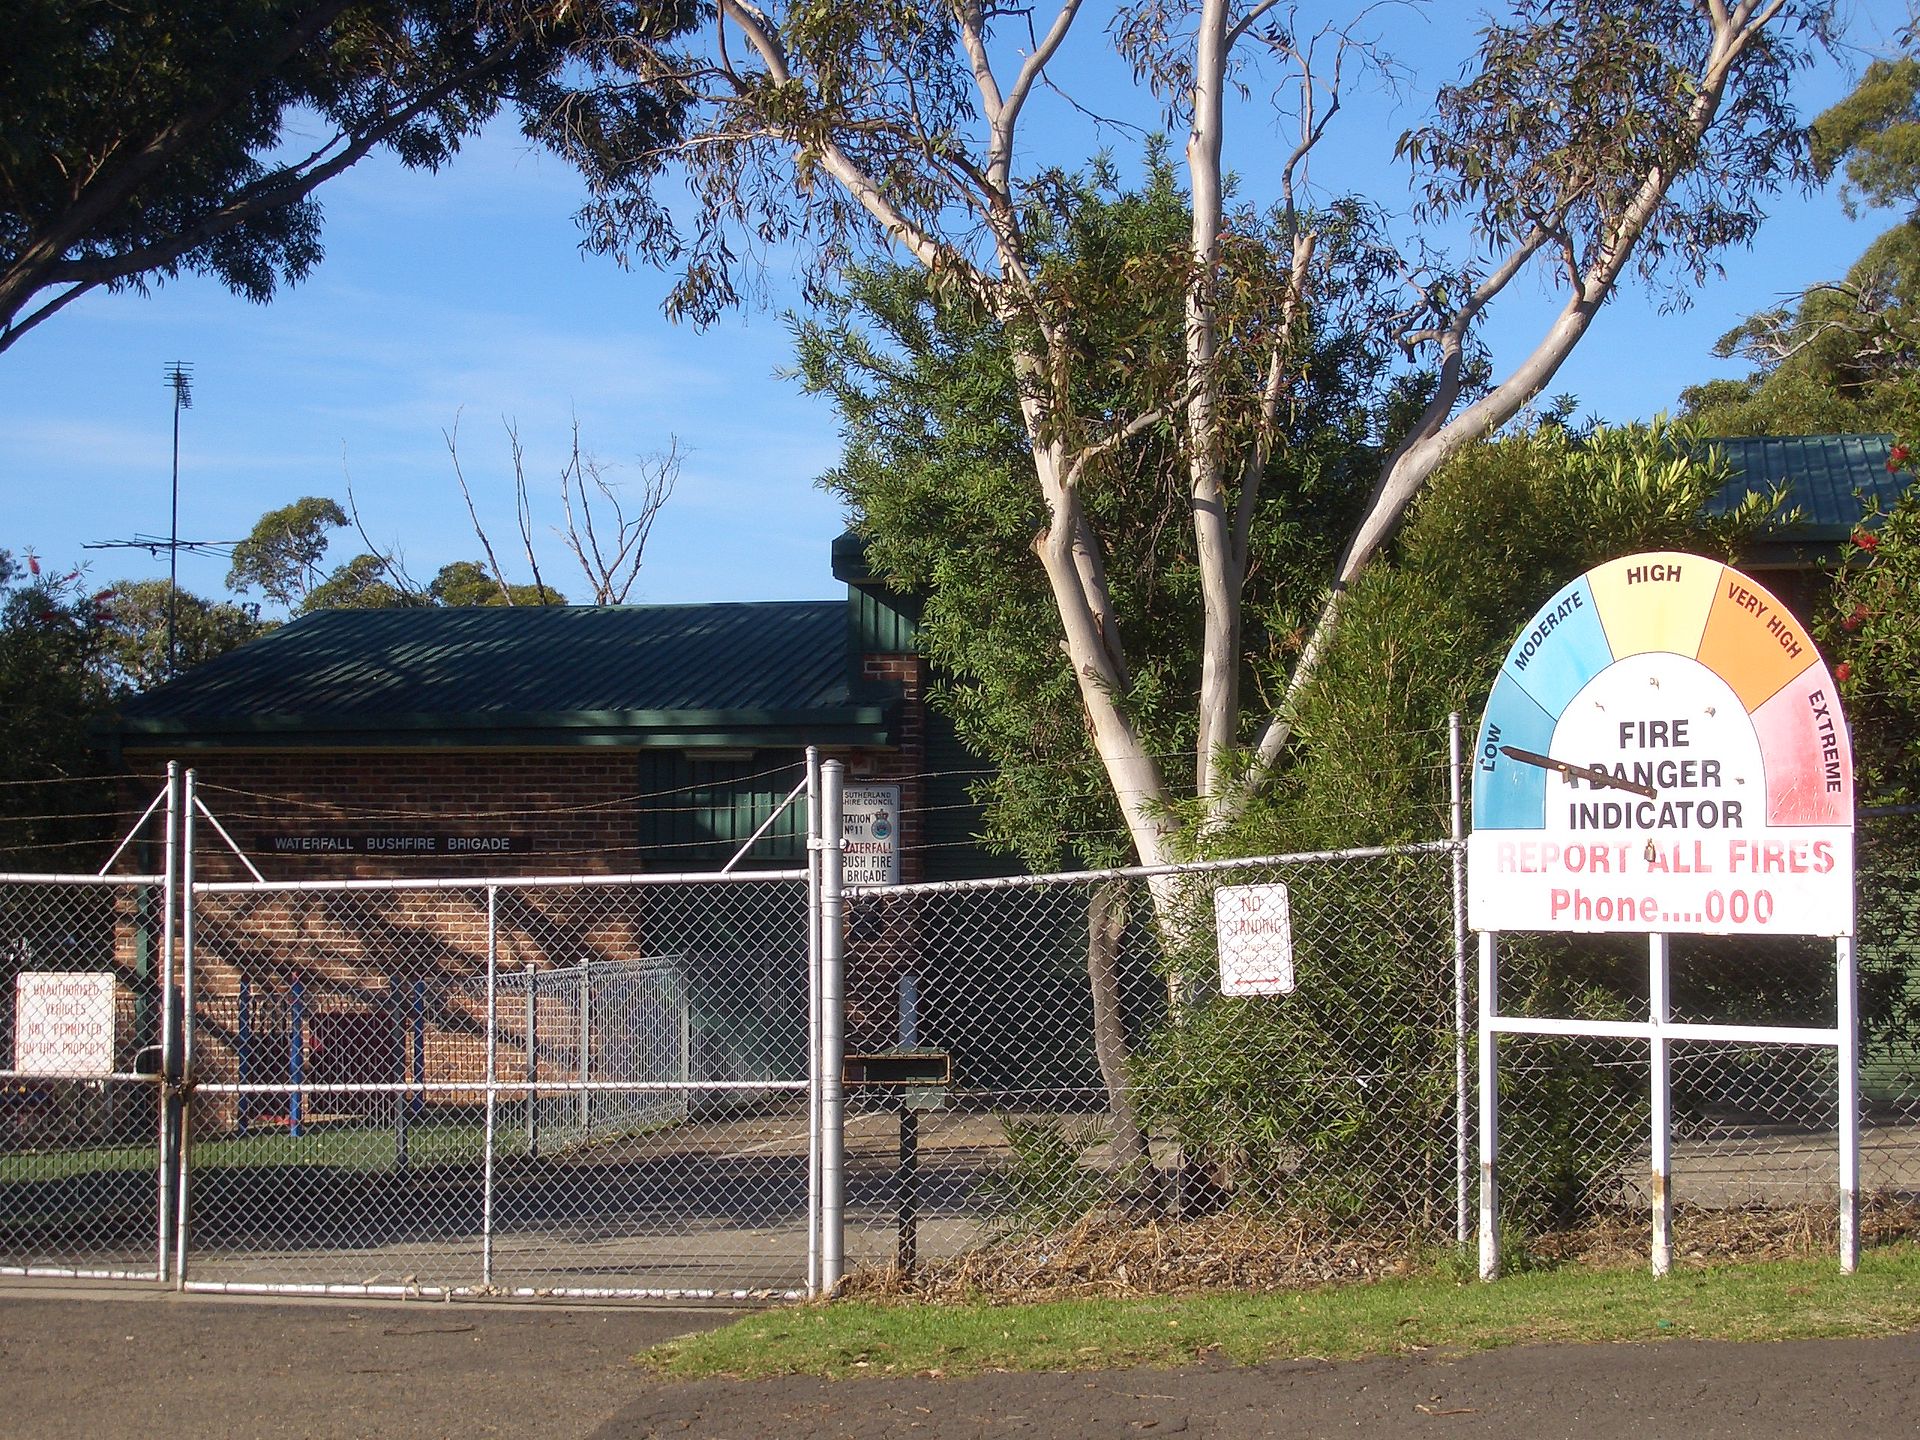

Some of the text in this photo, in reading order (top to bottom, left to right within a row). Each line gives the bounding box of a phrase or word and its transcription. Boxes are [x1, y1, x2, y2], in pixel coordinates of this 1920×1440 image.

[1626, 564, 1682, 585] HIGH
[1727, 582, 1803, 659] VERY HIGH
[1513, 591, 1584, 672] MODERATE
[1619, 719, 1690, 749] FIRE
[1808, 689, 1841, 793] EXTREME
[1482, 722, 1502, 772] LOW
[1588, 759, 1722, 790] DANGER
[844, 791, 891, 799] SUTHERLAND
[842, 814, 871, 824] TATION
[1569, 800, 1743, 830] INDICATOR
[275, 837, 510, 850] WATERFALL BUSHFIRE BRIGADE
[842, 855, 892, 868] BUSH FIRE
[1496, 839, 1835, 874] REPORT ALL FIRES
[847, 870, 887, 882] BRIGADE
[1241, 895, 1261, 912] NO
[1226, 917, 1281, 936] STANDING
[33, 984, 100, 996] UNAUTHORISED
[45, 1003, 87, 1016] VEHICLES
[28, 1023, 102, 1035] NOT PERMITTED
